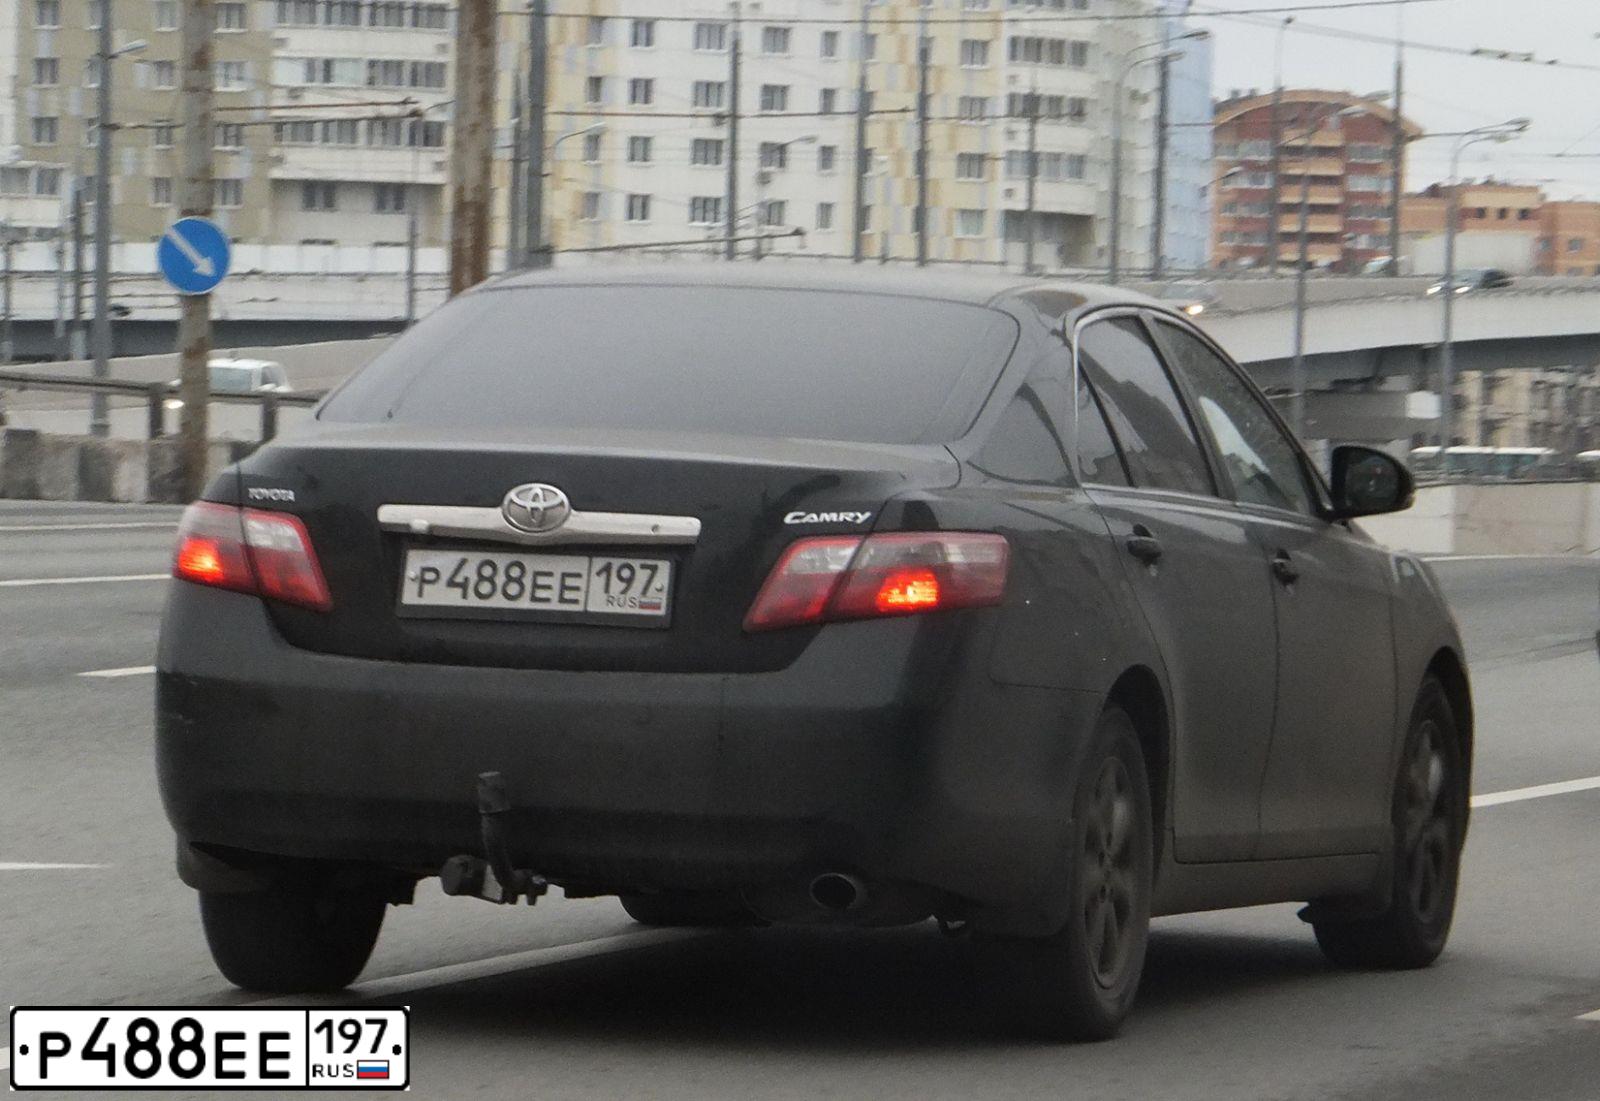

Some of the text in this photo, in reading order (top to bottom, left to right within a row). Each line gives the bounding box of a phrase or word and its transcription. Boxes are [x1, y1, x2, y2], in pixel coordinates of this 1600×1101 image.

[247, 487, 296, 502] TOYOTA
[783, 511, 872, 524] CAMRY
[595, 561, 659, 598] 197
[605, 595, 638, 610] RUS
